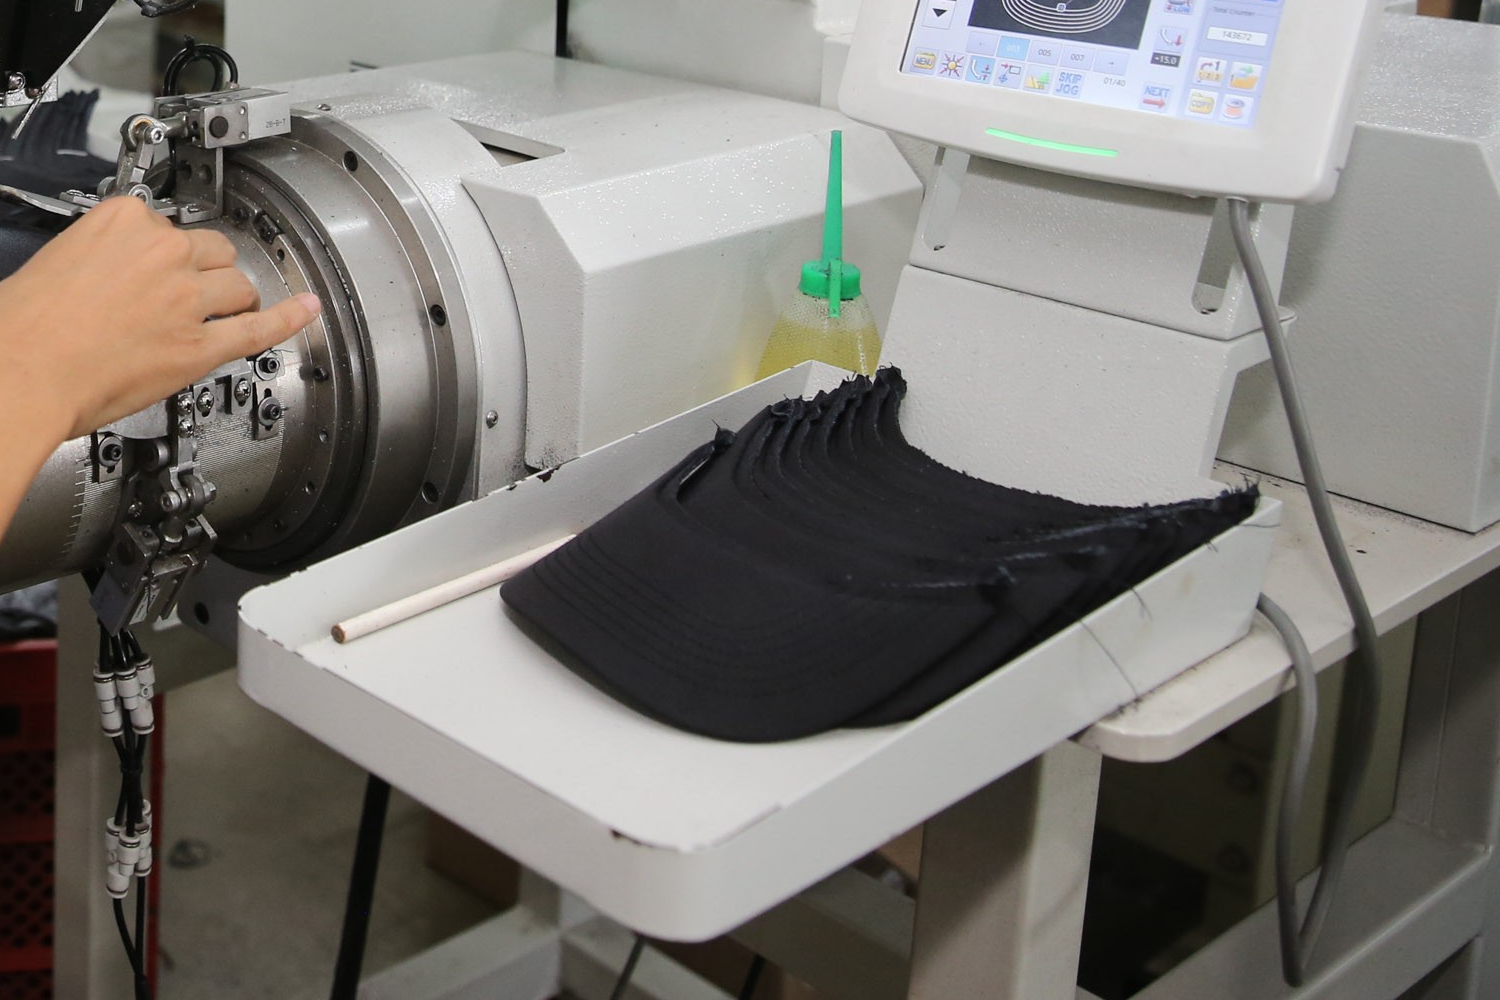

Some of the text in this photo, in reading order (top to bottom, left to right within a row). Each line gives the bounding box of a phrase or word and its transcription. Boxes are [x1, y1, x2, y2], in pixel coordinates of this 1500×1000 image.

[1038, 49, 1052, 57] 005
[1070, 53, 1085, 62] 007
[916, 57, 933, 67] MENU
[1058, 72, 1082, 84] SKIP
[1103, 77, 1126, 88] 01/40
[1056, 84, 1080, 96] JOG
[1144, 85, 1171, 98] NEXT
